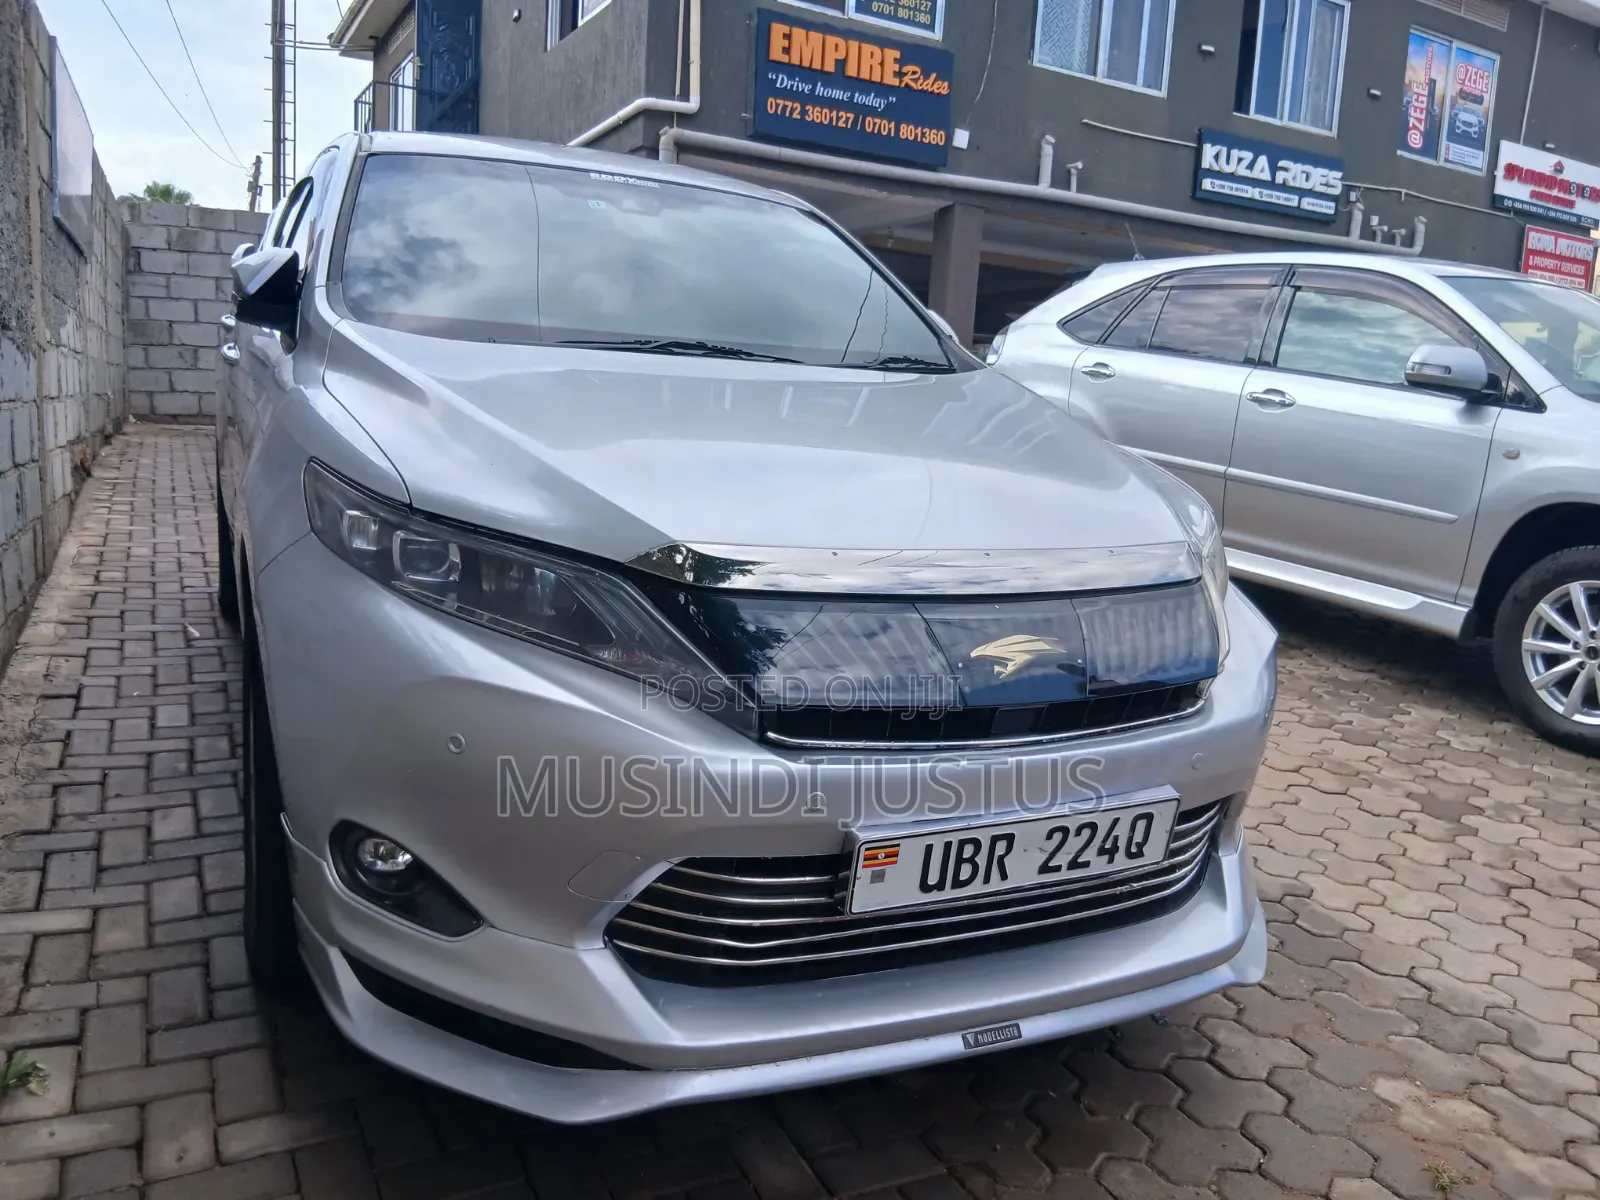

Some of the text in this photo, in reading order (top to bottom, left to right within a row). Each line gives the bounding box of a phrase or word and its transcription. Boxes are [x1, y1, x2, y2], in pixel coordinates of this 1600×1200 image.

[872, 3, 931, 25] 0701 801360
[768, 22, 950, 96] EMPIRE Rides
[815, 82, 851, 102] home
[1456, 62, 1490, 94] @ZEGE
[1462, 86, 1482, 97] MOTORS
[1407, 44, 1434, 150] @ZEGE MOTORS
[767, 97, 946, 146] 0772 360127 / 0701 801360
[1201, 143, 1343, 196] KUZA RIDES
[1503, 162, 1559, 191] SPLENDID
[1556, 238, 1594, 262] MOTORS
[1533, 256, 1561, 272] PROPERTY
[1561, 261, 1585, 276] SERVICES
[918, 811, 1154, 894] UBR 224Q
[977, 1026, 1019, 1044] MODELLISTA
